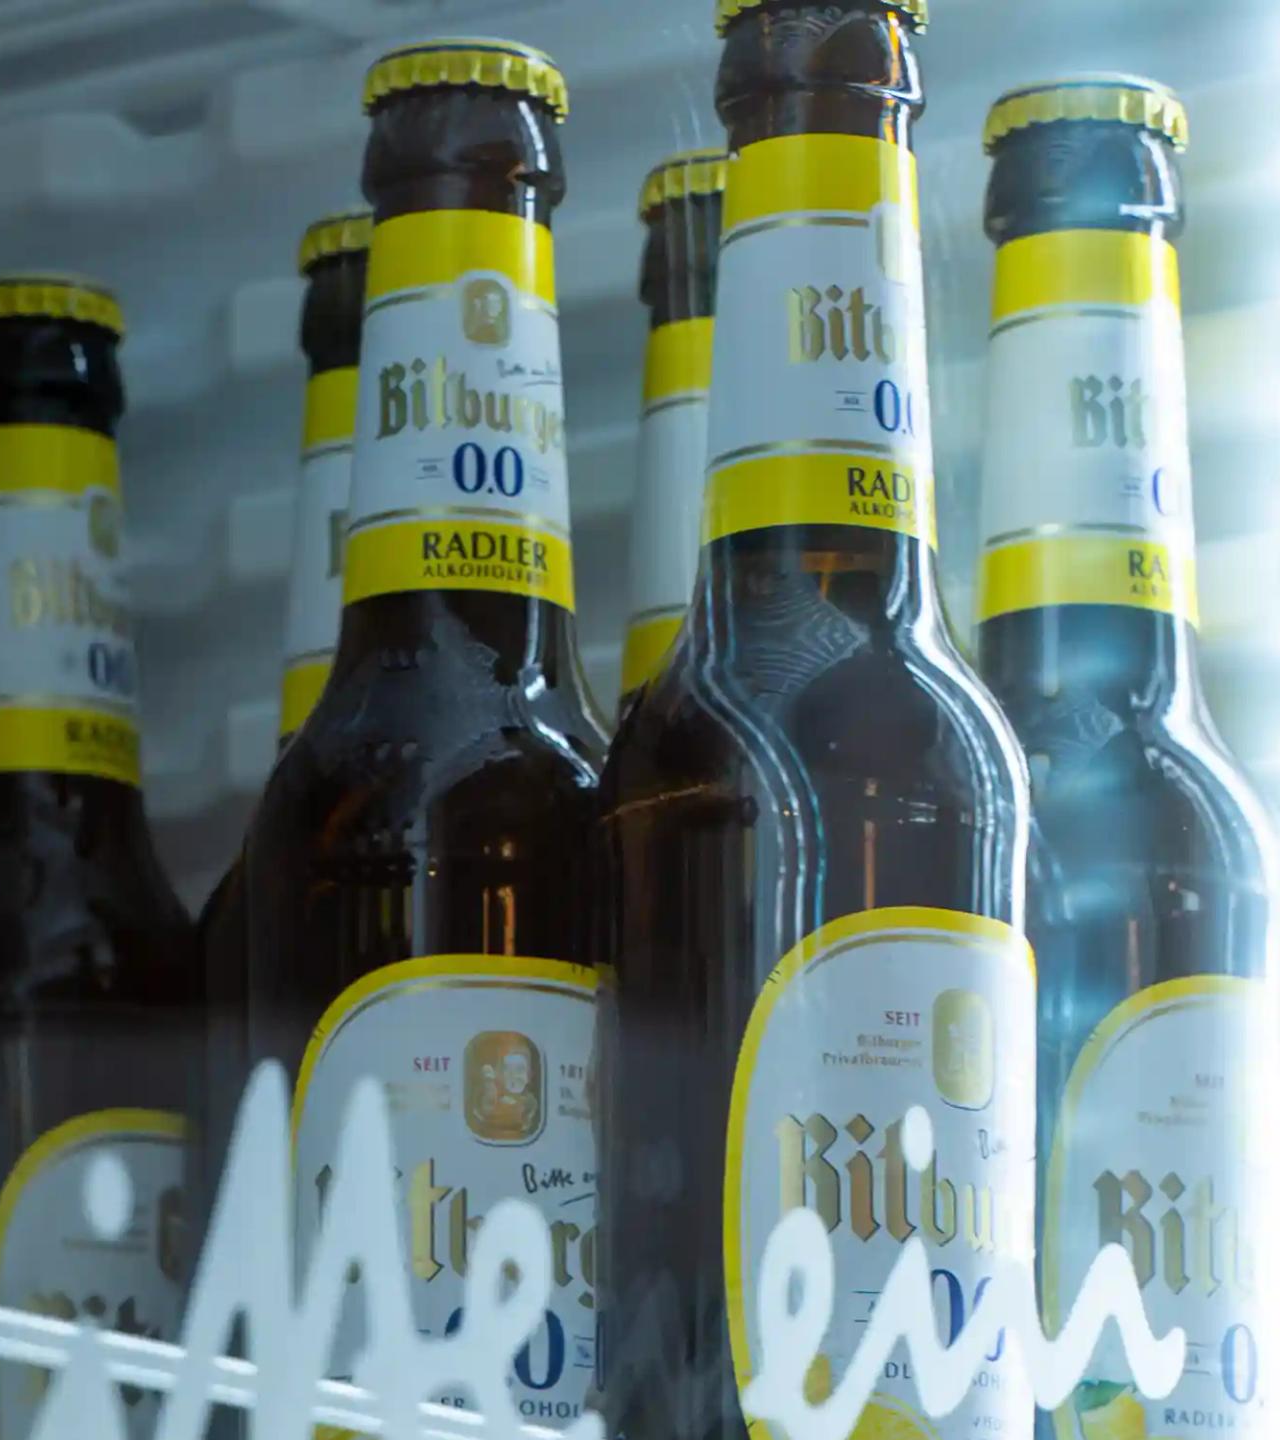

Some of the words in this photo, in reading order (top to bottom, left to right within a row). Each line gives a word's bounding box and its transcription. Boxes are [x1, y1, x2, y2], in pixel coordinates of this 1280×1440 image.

[452, 441, 525, 497] 0.0
[422, 531, 548, 572] RADLER
[884, 1010, 921, 1027] SEIT
[412, 1056, 452, 1073] SEIT
